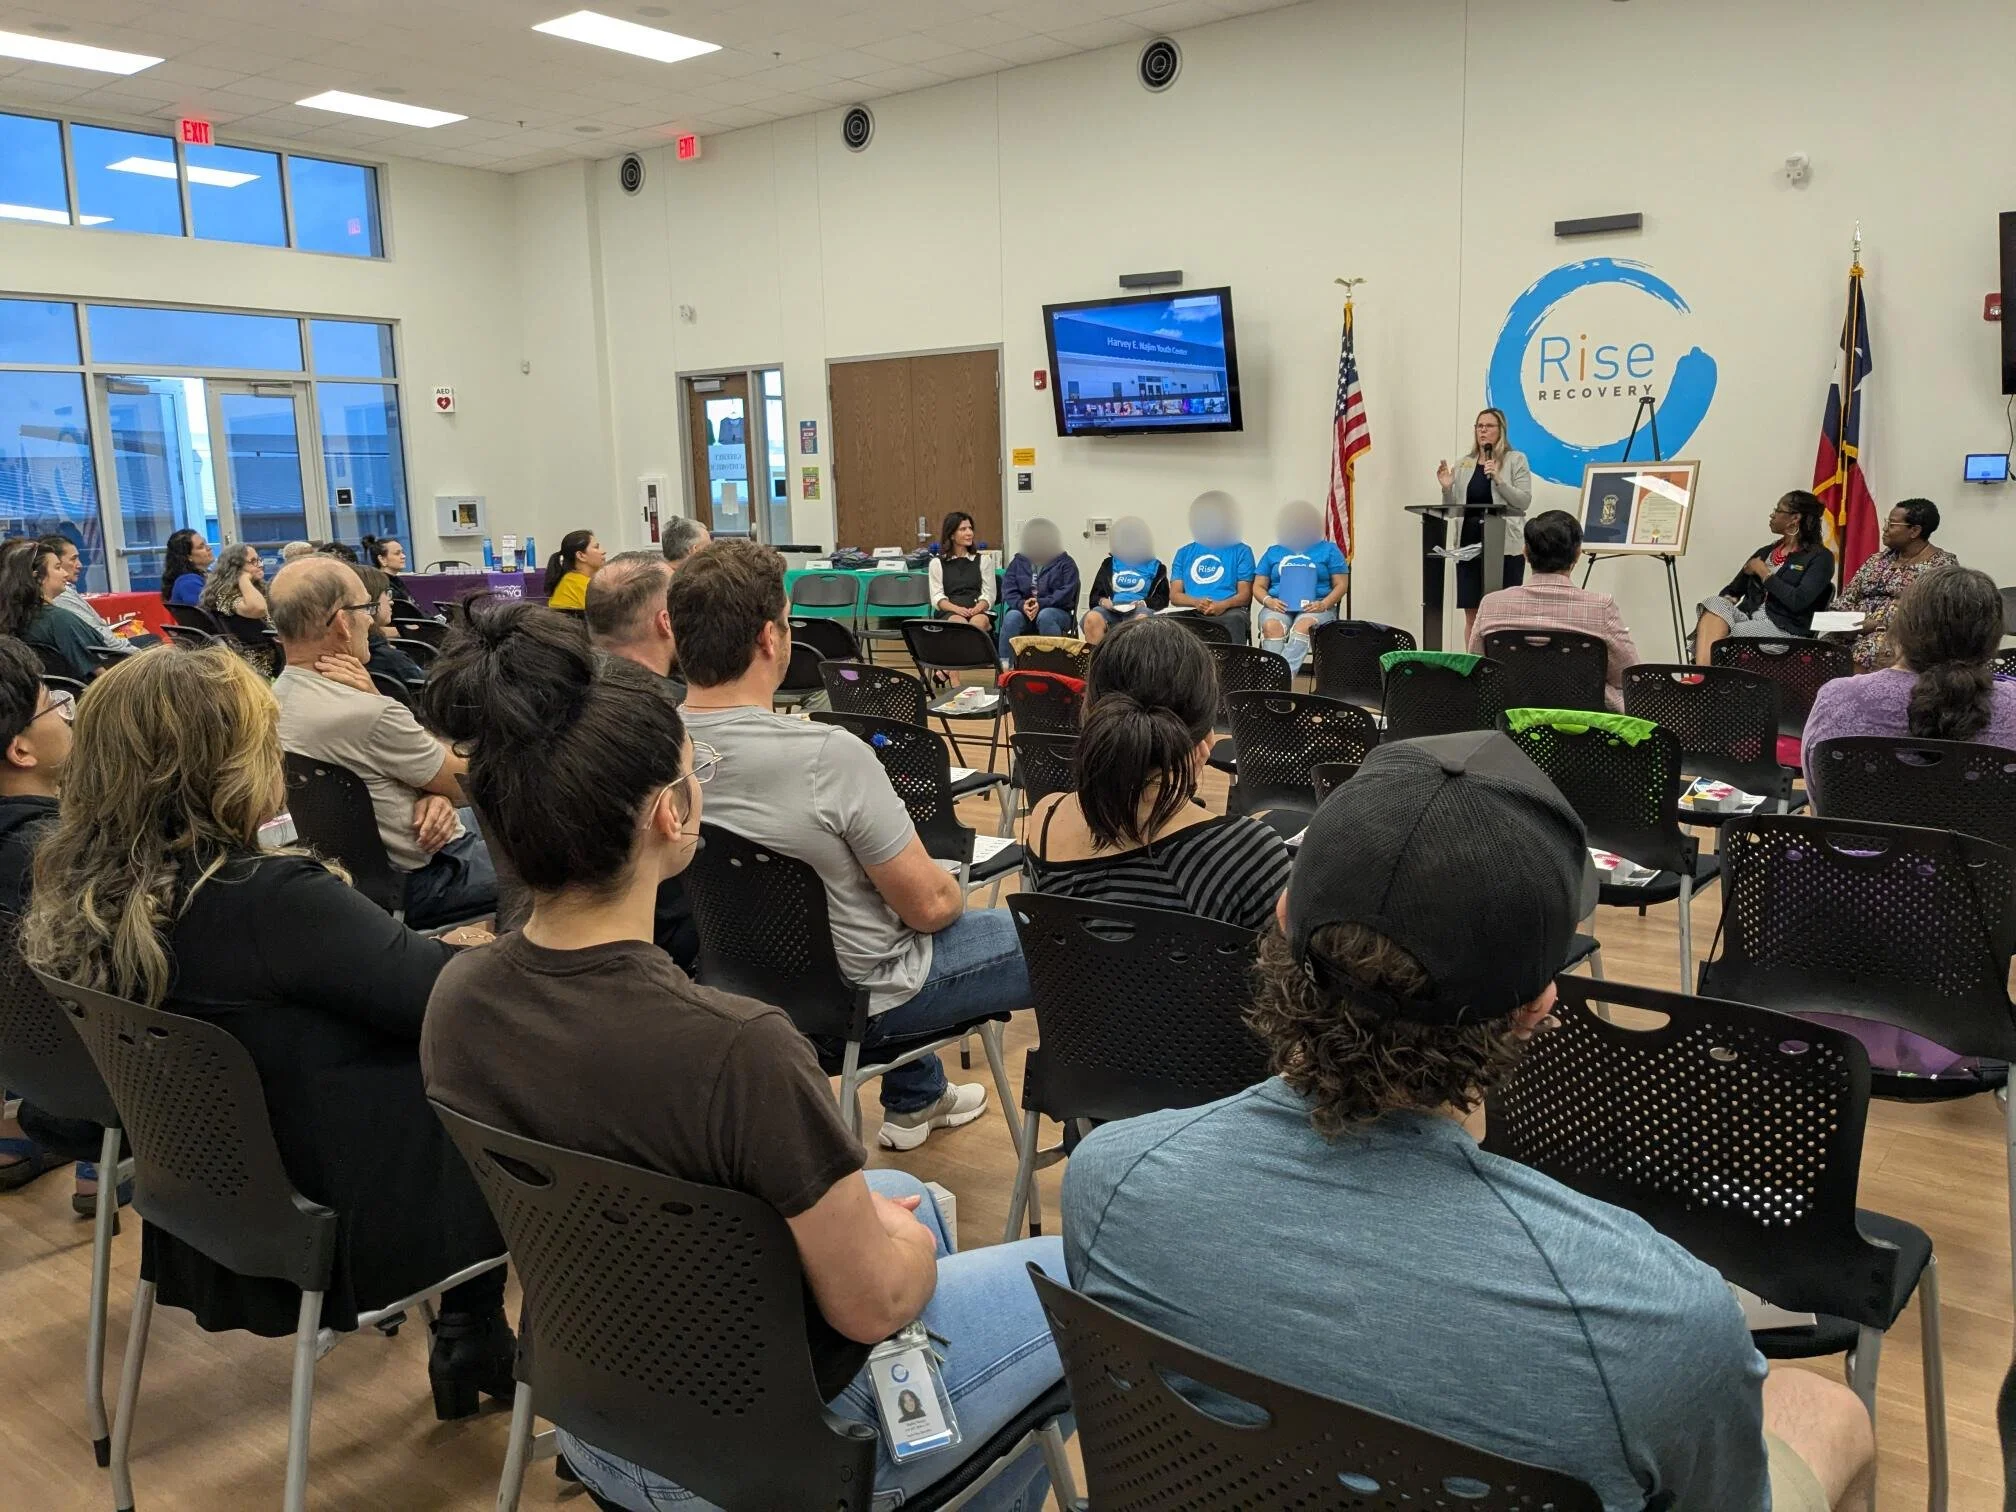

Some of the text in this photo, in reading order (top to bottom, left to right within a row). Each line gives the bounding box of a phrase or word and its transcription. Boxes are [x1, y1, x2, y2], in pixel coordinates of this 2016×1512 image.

[182, 119, 209, 144] EXIT
[679, 136, 695, 158] EXIT
[1107, 337, 1132, 350] Harvey
[1132, 339, 1139, 350] E.
[1156, 344, 1172, 354] Youth
[1540, 334, 1655, 383] Rise
[1538, 384, 1653, 401] RECOVERY
[1198, 565, 1216, 573] Rise
[1117, 576, 1137, 584] Rise
